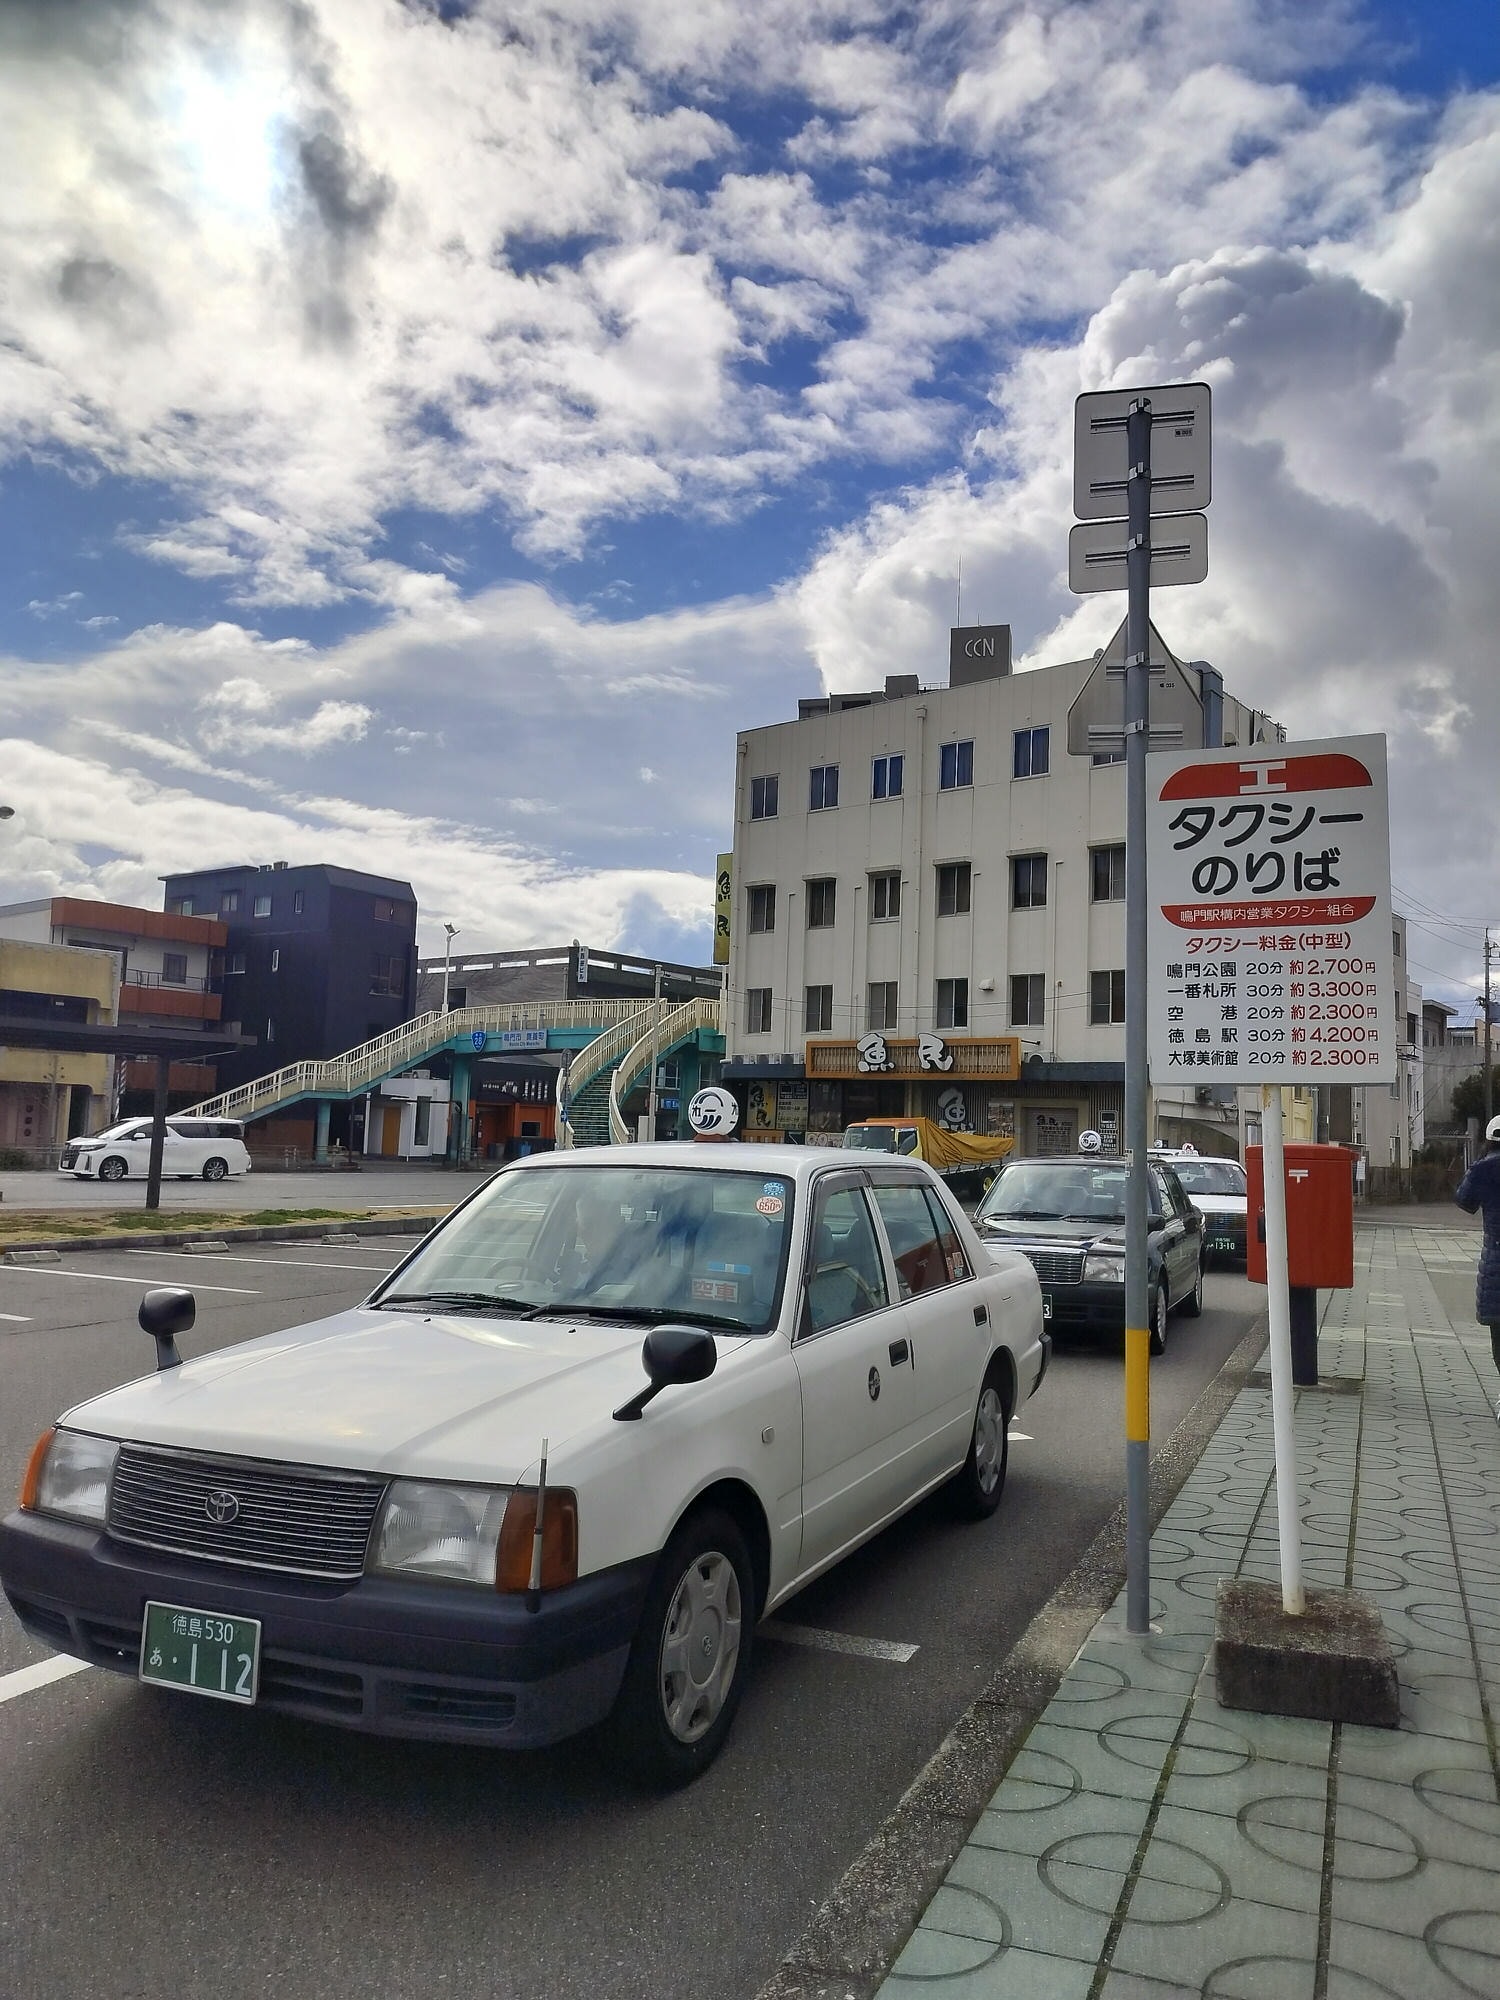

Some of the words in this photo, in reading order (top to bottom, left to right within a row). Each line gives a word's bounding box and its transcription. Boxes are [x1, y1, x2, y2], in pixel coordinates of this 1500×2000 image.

[965, 658, 994, 677] CCN
[1168, 802, 1364, 850] タクシー
[1192, 847, 1341, 895] のりば
[718, 871, 730, 937] 魚民
[1180, 903, 1355, 923] 鳴門駅構内営業タクシー組合
[1167, 961, 1237, 979] 鳴門公園
[1246, 962, 1284, 975] 20分
[1167, 982, 1237, 999] 一番札所
[1246, 985, 1284, 997] 30分
[1247, 1006, 1285, 1020] 20分
[474, 1037, 482, 1045] 28
[1247, 1029, 1286, 1042] 30分
[857, 1032, 953, 1072] 魚民
[1168, 1050, 1239, 1066] 大塚美術館
[1248, 1051, 1286, 1064] 20分
